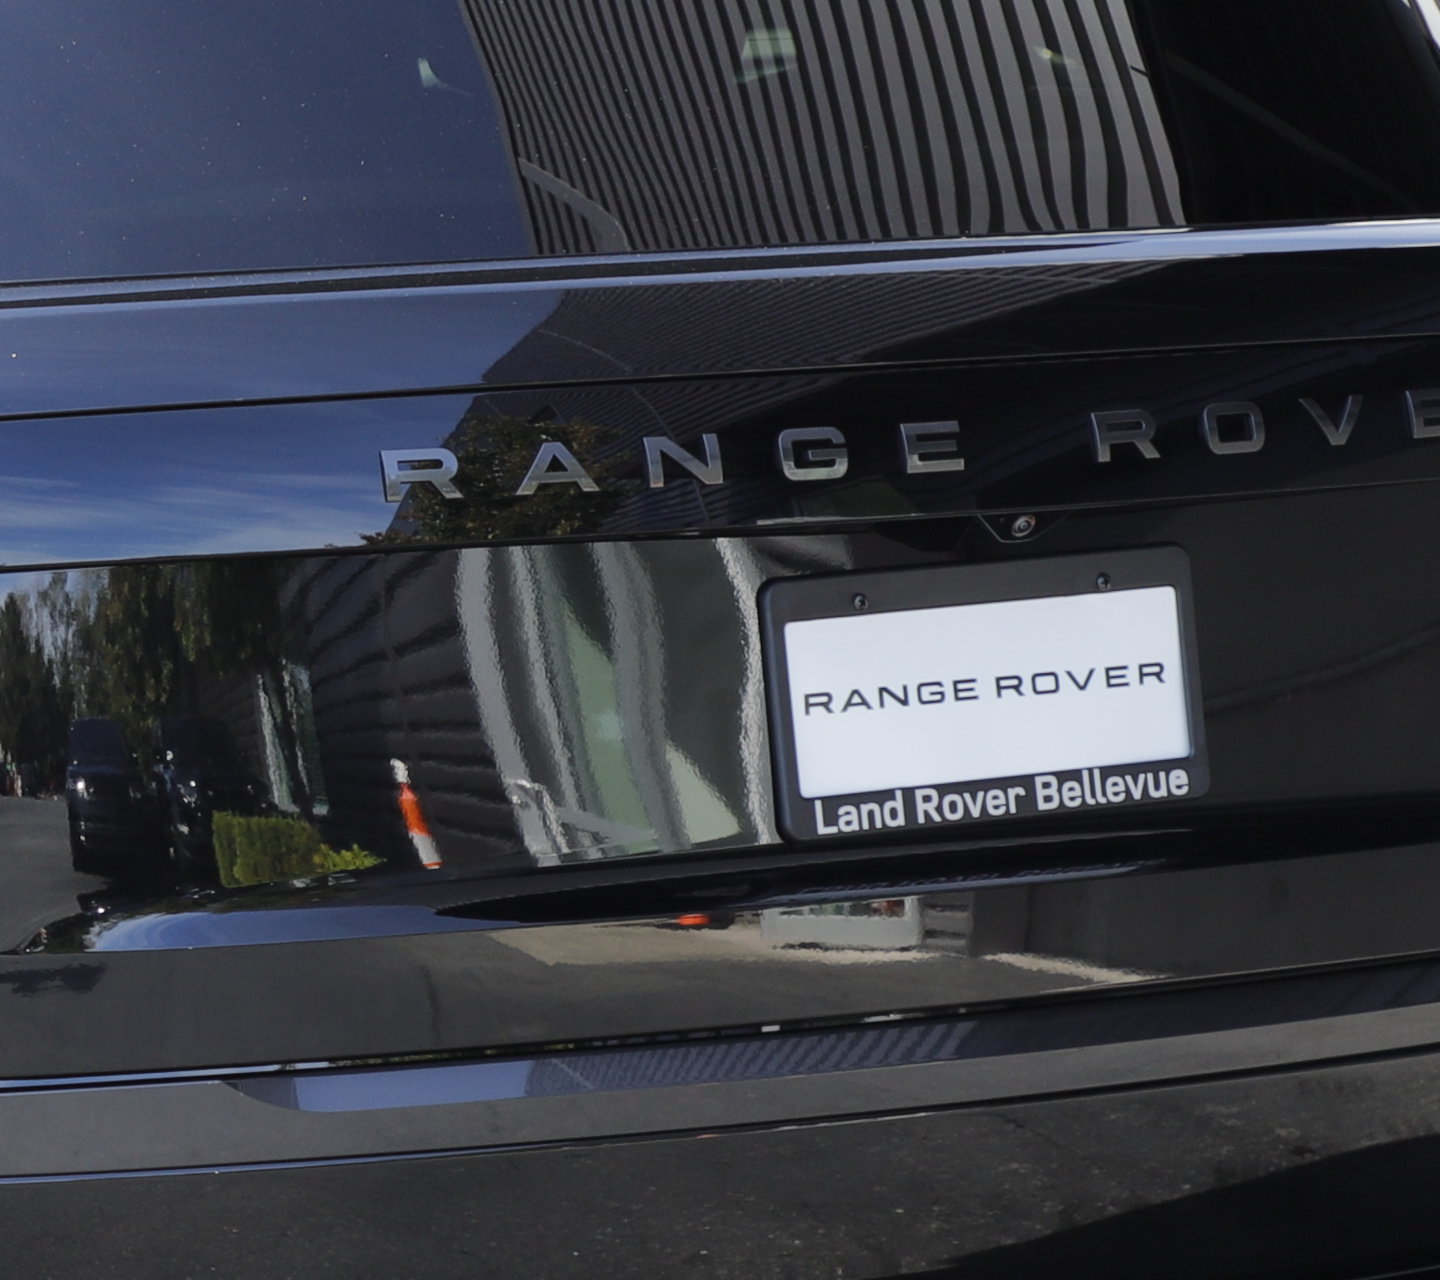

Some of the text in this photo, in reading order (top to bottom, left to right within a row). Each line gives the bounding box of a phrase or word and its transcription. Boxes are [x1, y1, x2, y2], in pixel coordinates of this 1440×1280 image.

[380, 421, 965, 503] RANGE
[804, 662, 1166, 715] RANGE ROVER
[814, 767, 1190, 835] Land Rover Bellevue
